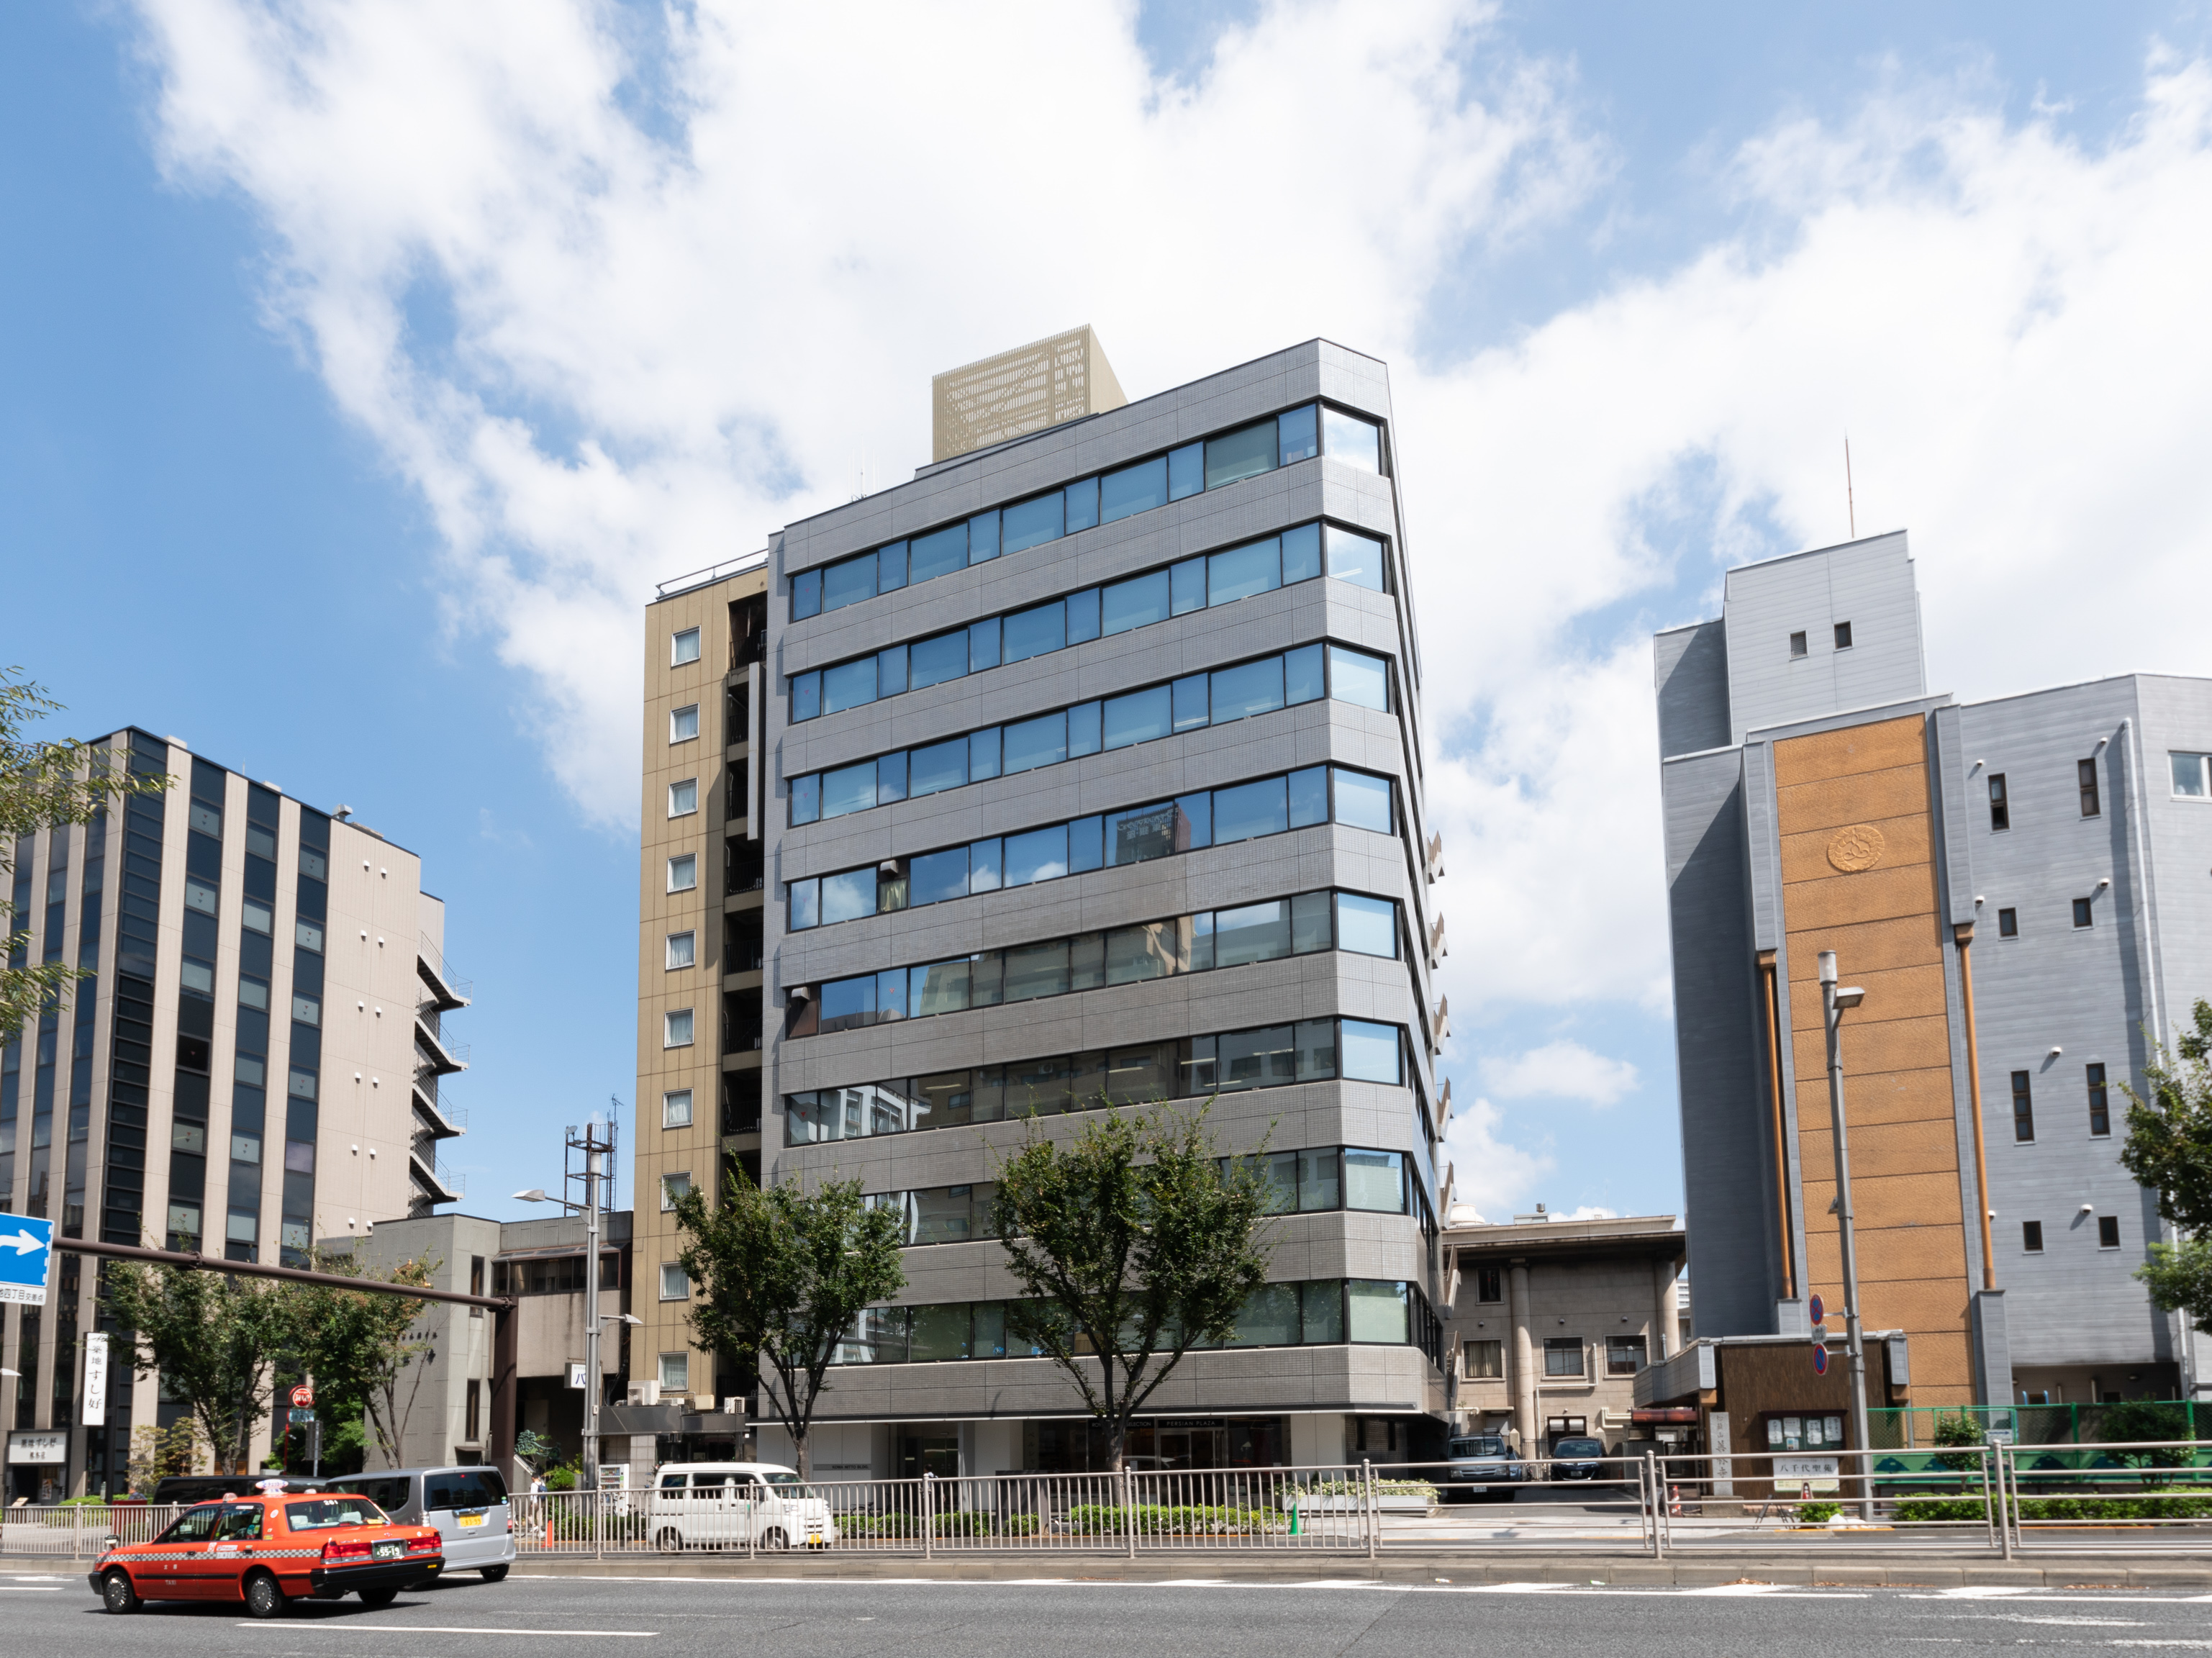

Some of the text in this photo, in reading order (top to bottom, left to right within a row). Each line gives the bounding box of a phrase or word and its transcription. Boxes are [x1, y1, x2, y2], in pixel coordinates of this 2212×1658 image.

[88, 1345, 102, 1410] 築地すし好
[1780, 1464, 1833, 1472] 八千代聖苑
[379, 1546, 400, 1557] 55-19
